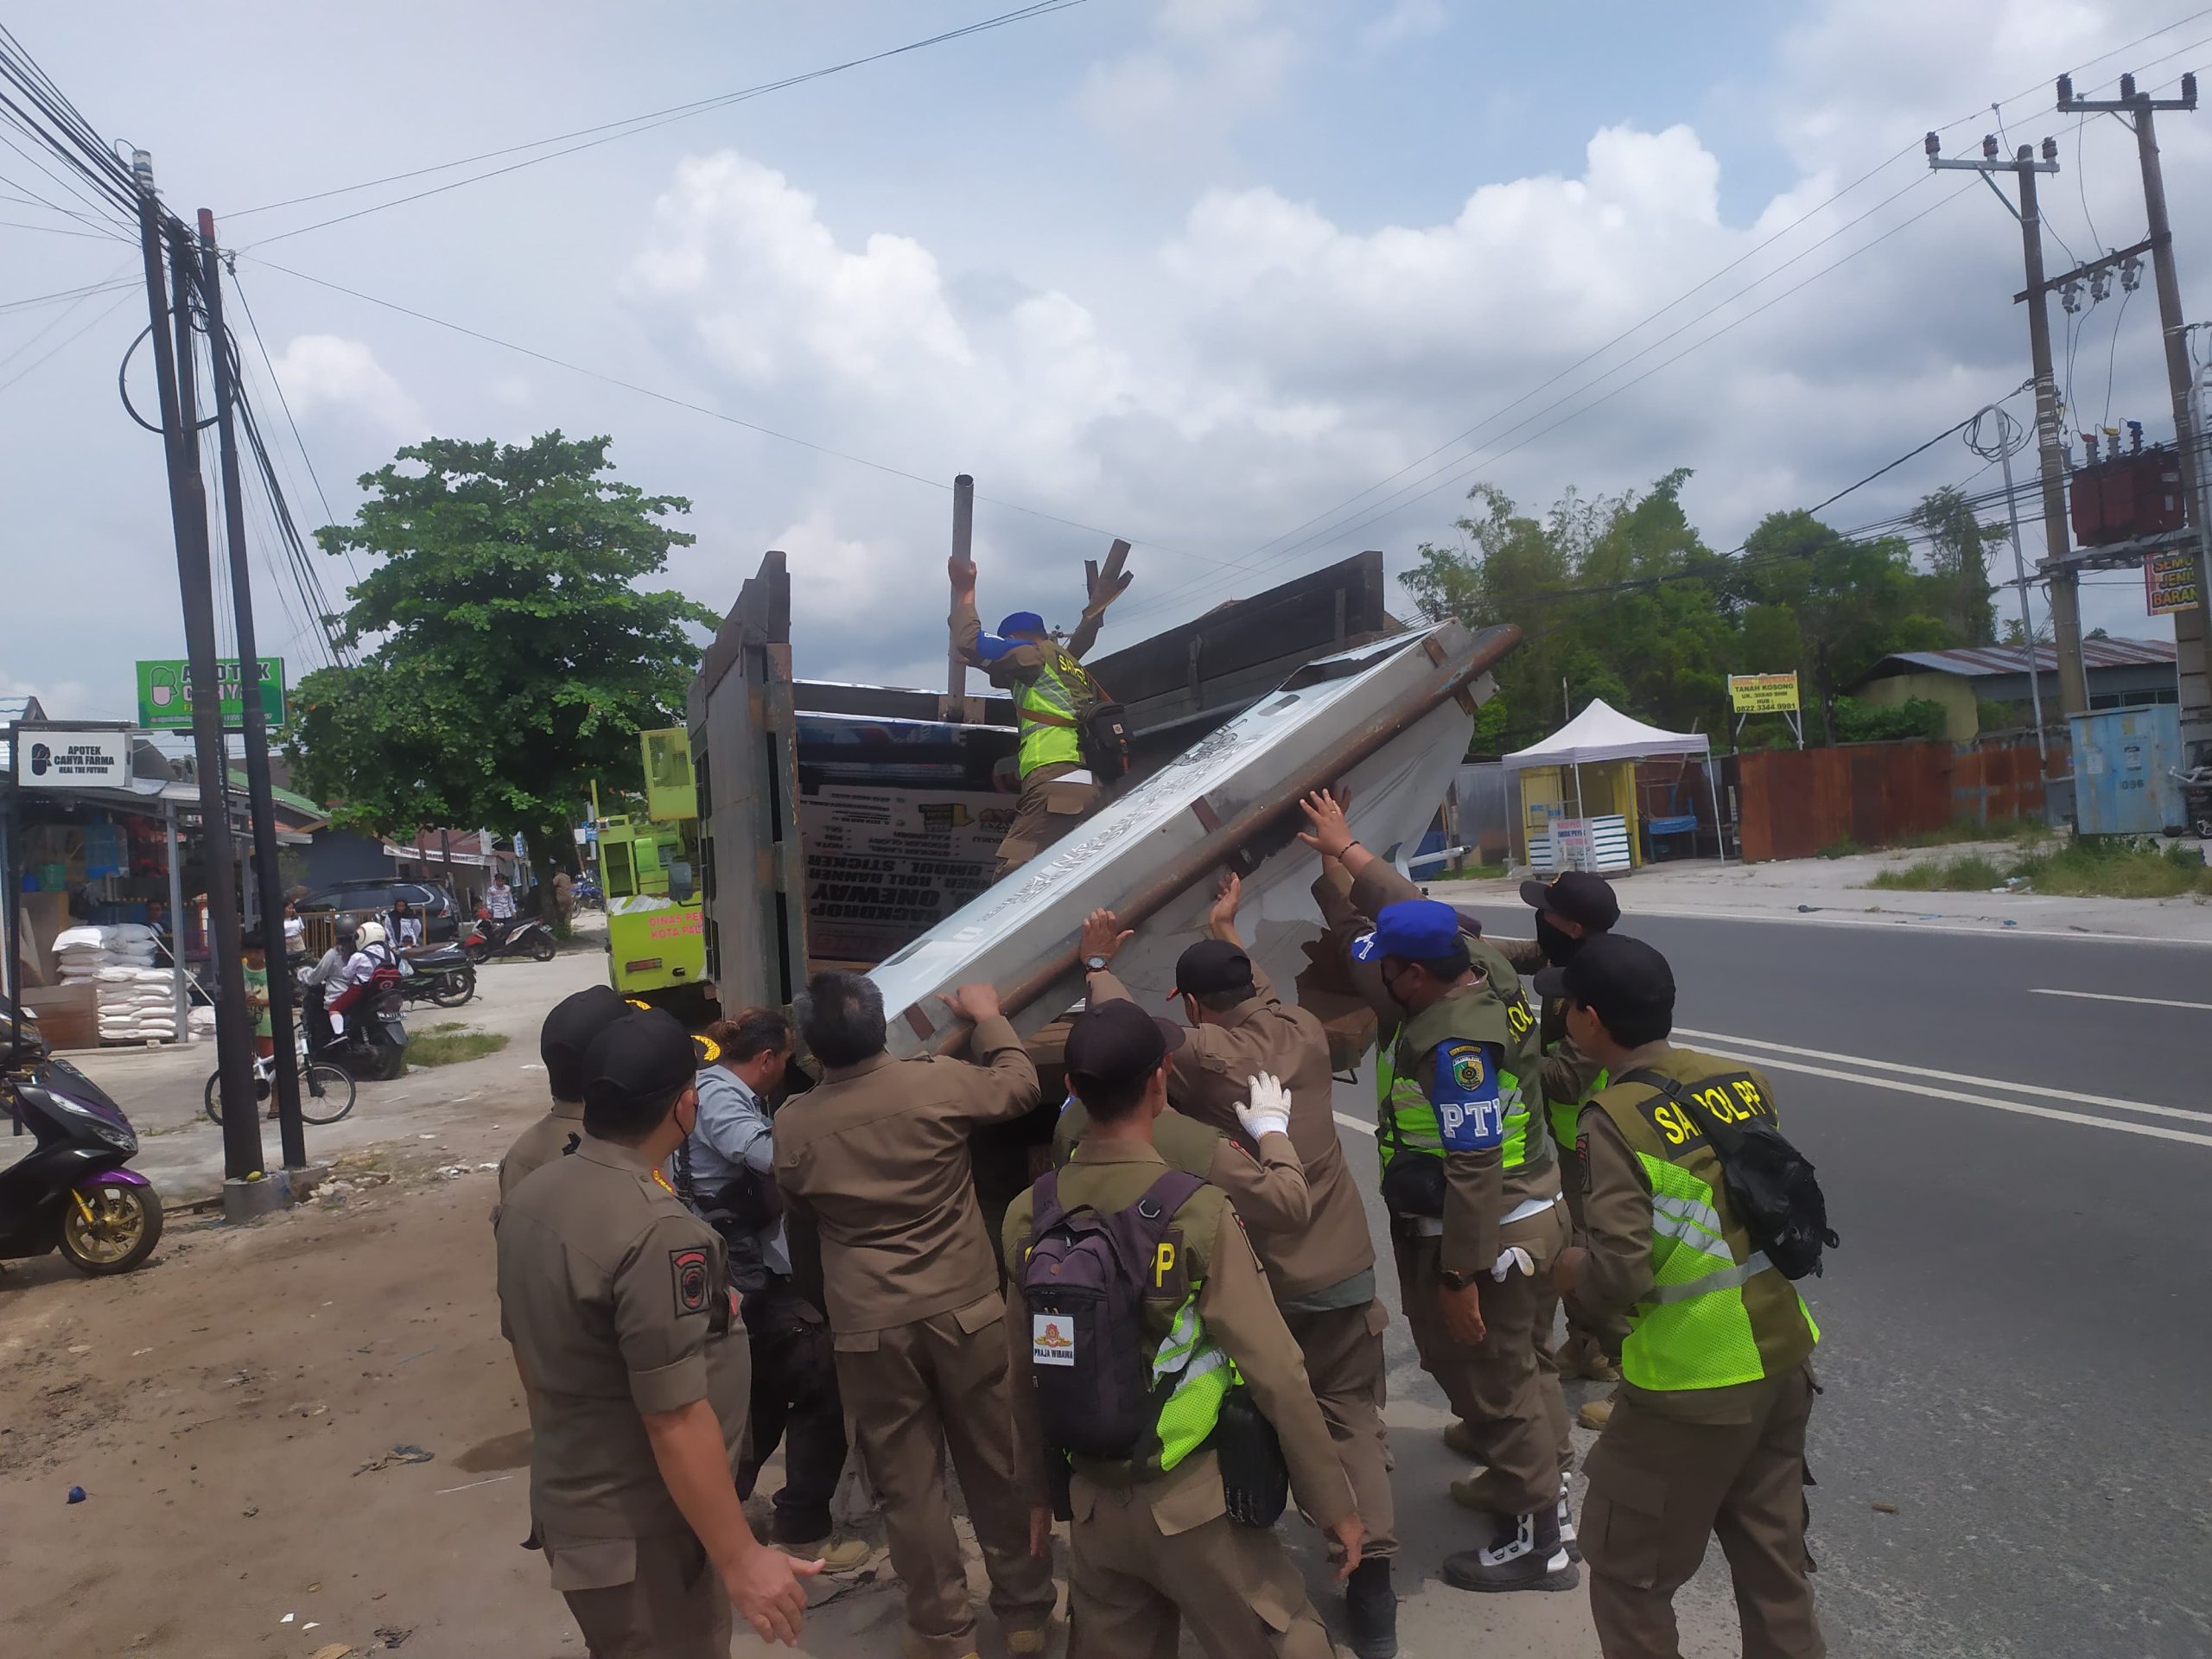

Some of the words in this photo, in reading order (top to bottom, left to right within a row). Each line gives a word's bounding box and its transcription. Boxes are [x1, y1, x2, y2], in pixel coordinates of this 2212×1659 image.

[67, 746, 101, 755] APOTEK
[54, 756, 84, 765] CAHYA
[86, 756, 114, 766] FARMA
[809, 855, 896, 872] STICKER
[810, 868, 884, 885] BANNER
[810, 884, 941, 907] ONEWAY
[650, 913, 683, 927] DINAS
[650, 928, 679, 940] KOTA
[1732, 1080, 1767, 1116] PP
[1034, 1348, 1051, 1357] PRAJA
[1051, 1350, 1073, 1359] WIBAWA
